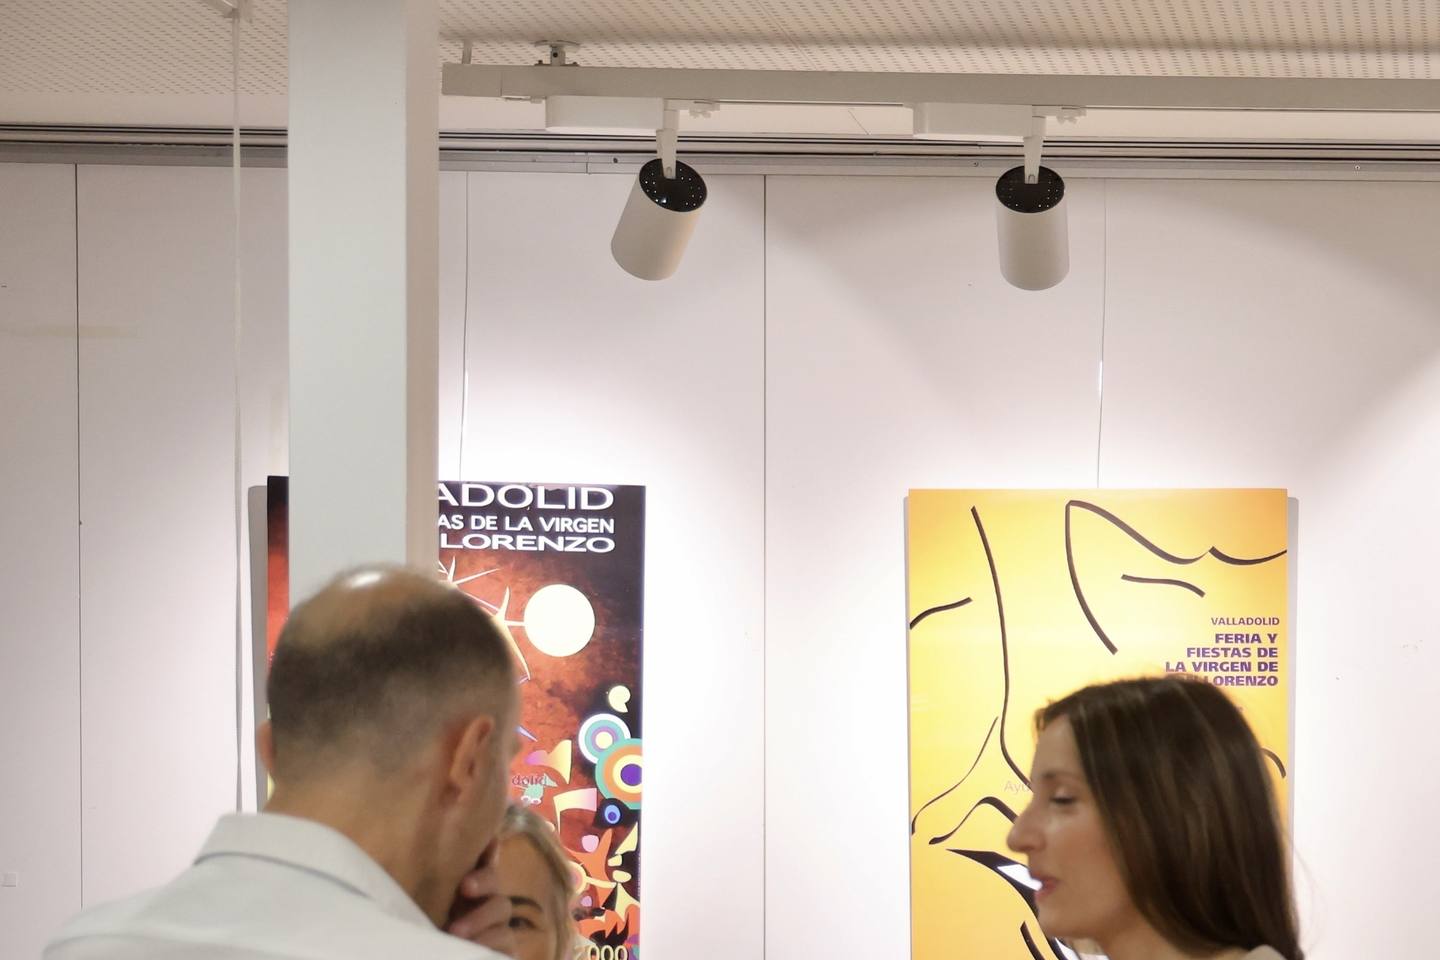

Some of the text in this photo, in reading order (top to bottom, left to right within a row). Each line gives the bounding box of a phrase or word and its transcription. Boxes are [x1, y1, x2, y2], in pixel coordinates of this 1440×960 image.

[471, 515, 498, 531] DE
[505, 516, 533, 532] LA
[539, 517, 615, 533] VIRGEN
[440, 533, 615, 553] LORENZO
[1211, 617, 1280, 626] VALLADOLID
[1215, 633, 1278, 644] FERIA Y
[1186, 647, 1278, 658] FIESTAS DE
[1165, 661, 1279, 673] LA VIRGEN DE
